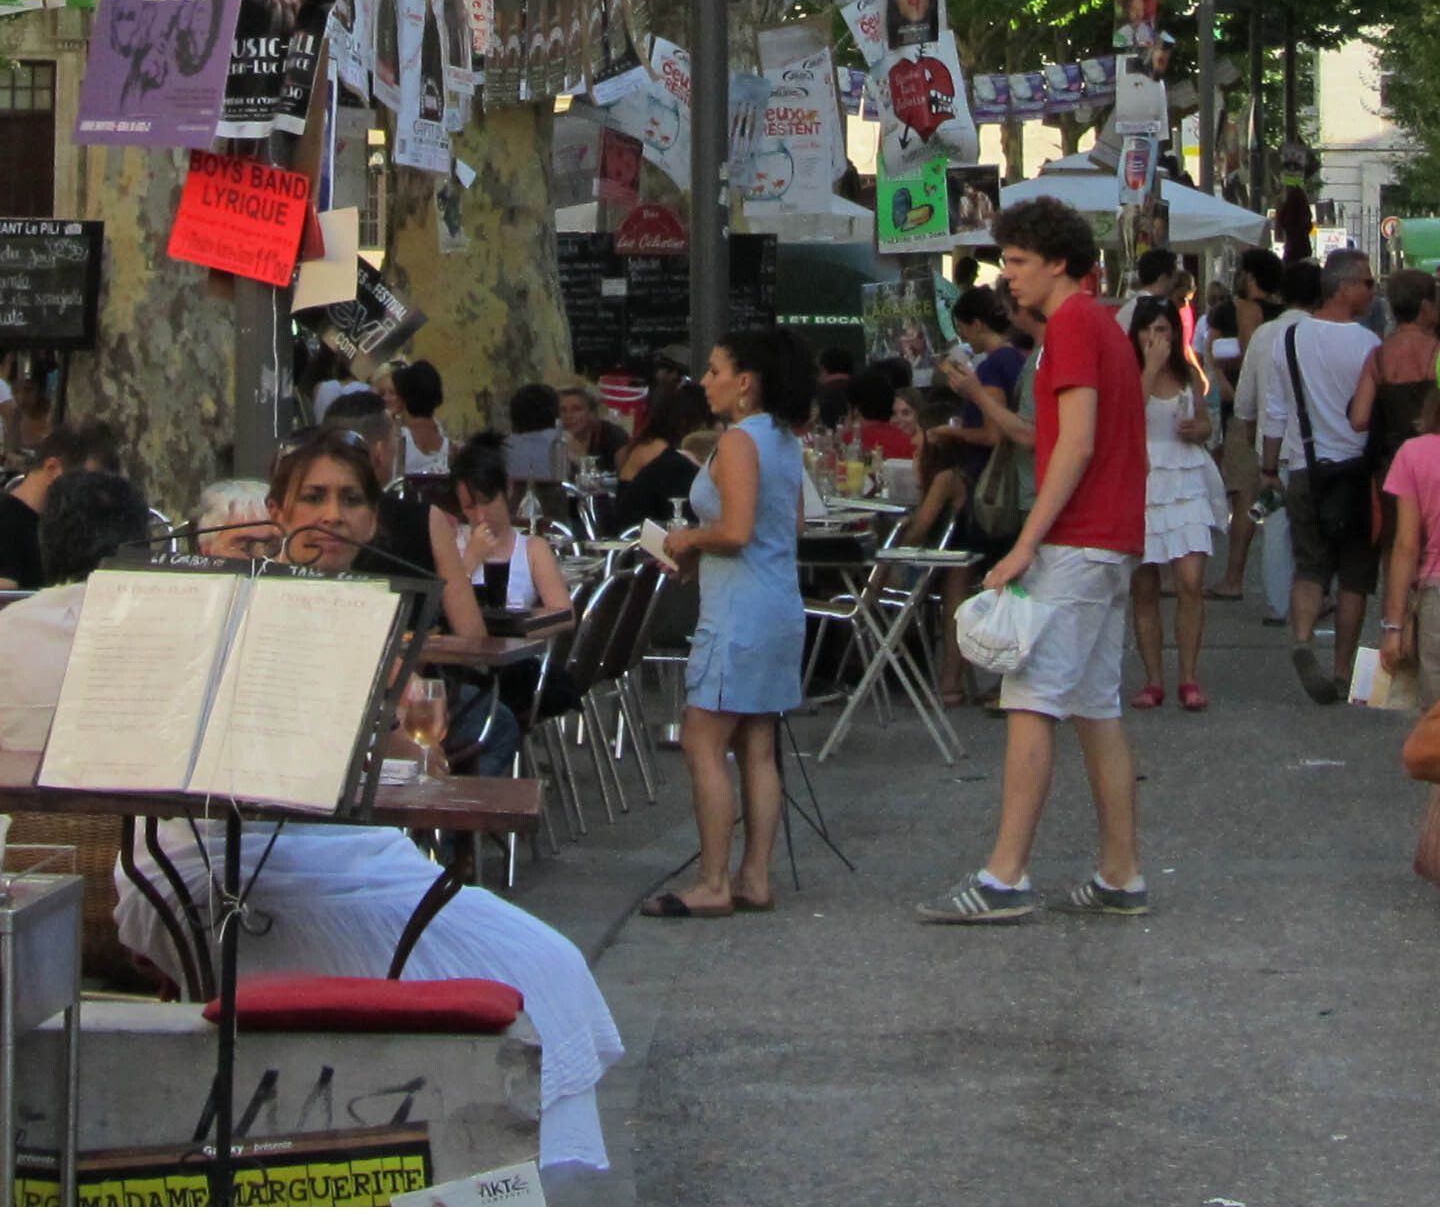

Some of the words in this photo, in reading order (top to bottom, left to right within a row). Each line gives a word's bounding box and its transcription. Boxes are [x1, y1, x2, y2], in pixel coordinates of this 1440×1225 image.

[190, 150, 244, 185] BOYS
[202, 184, 289, 226] LYRIQUE
[25, 222, 37, 235] Le
[0, 244, 20, 262] du
[373, 282, 408, 322] FESTIVAL
[789, 315, 810, 324] ET
